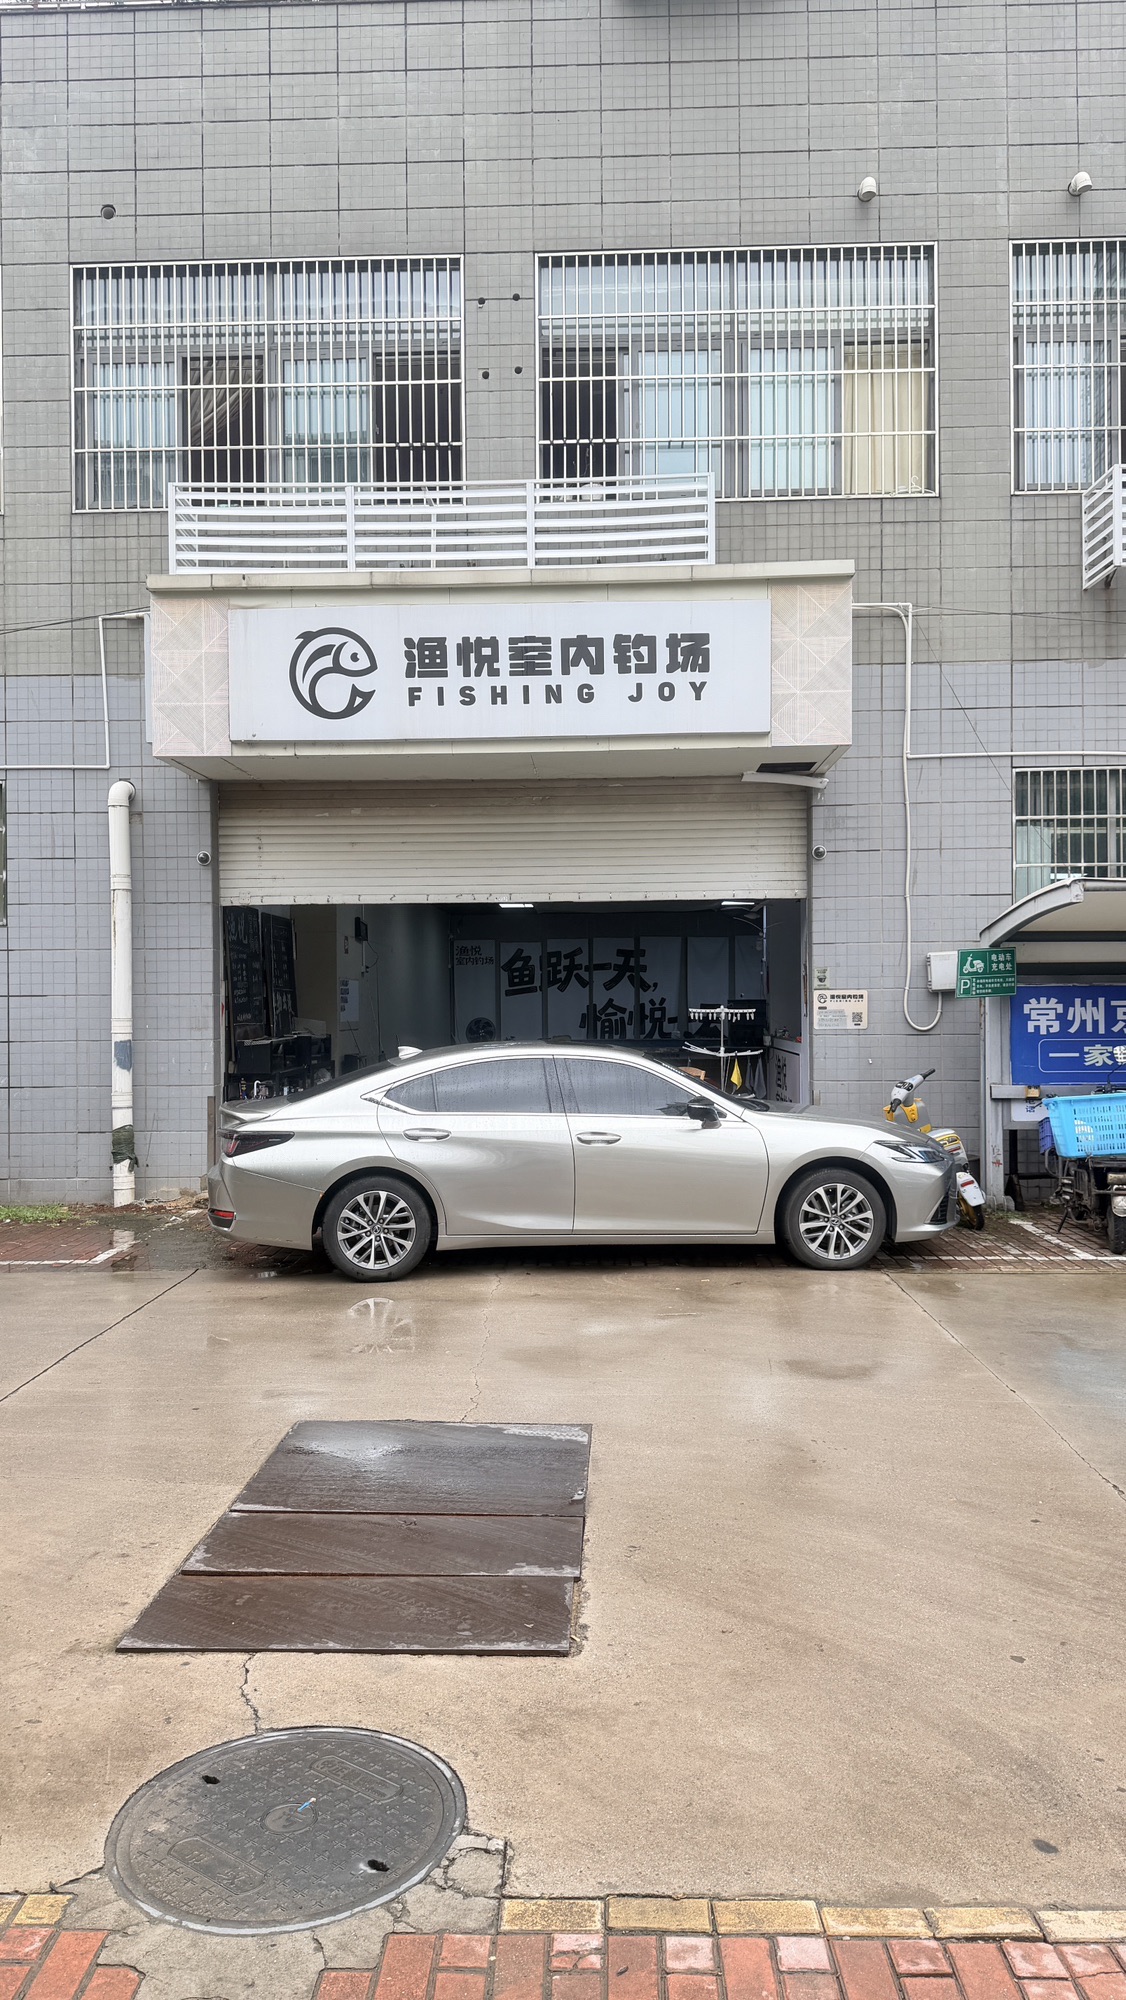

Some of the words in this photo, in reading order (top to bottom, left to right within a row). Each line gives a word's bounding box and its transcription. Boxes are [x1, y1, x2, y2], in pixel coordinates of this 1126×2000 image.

[404, 633, 710, 678] 渔悦室内钓场
[408, 684, 595, 706] FISHING
[628, 682, 708, 702] JOY
[455, 945, 482, 956] 渔悦
[455, 956, 494, 966] 室内钓场
[991, 953, 1012, 962] 电动车
[991, 963, 1013, 971] 充电处
[1049, 1044, 1126, 1067] 一家
